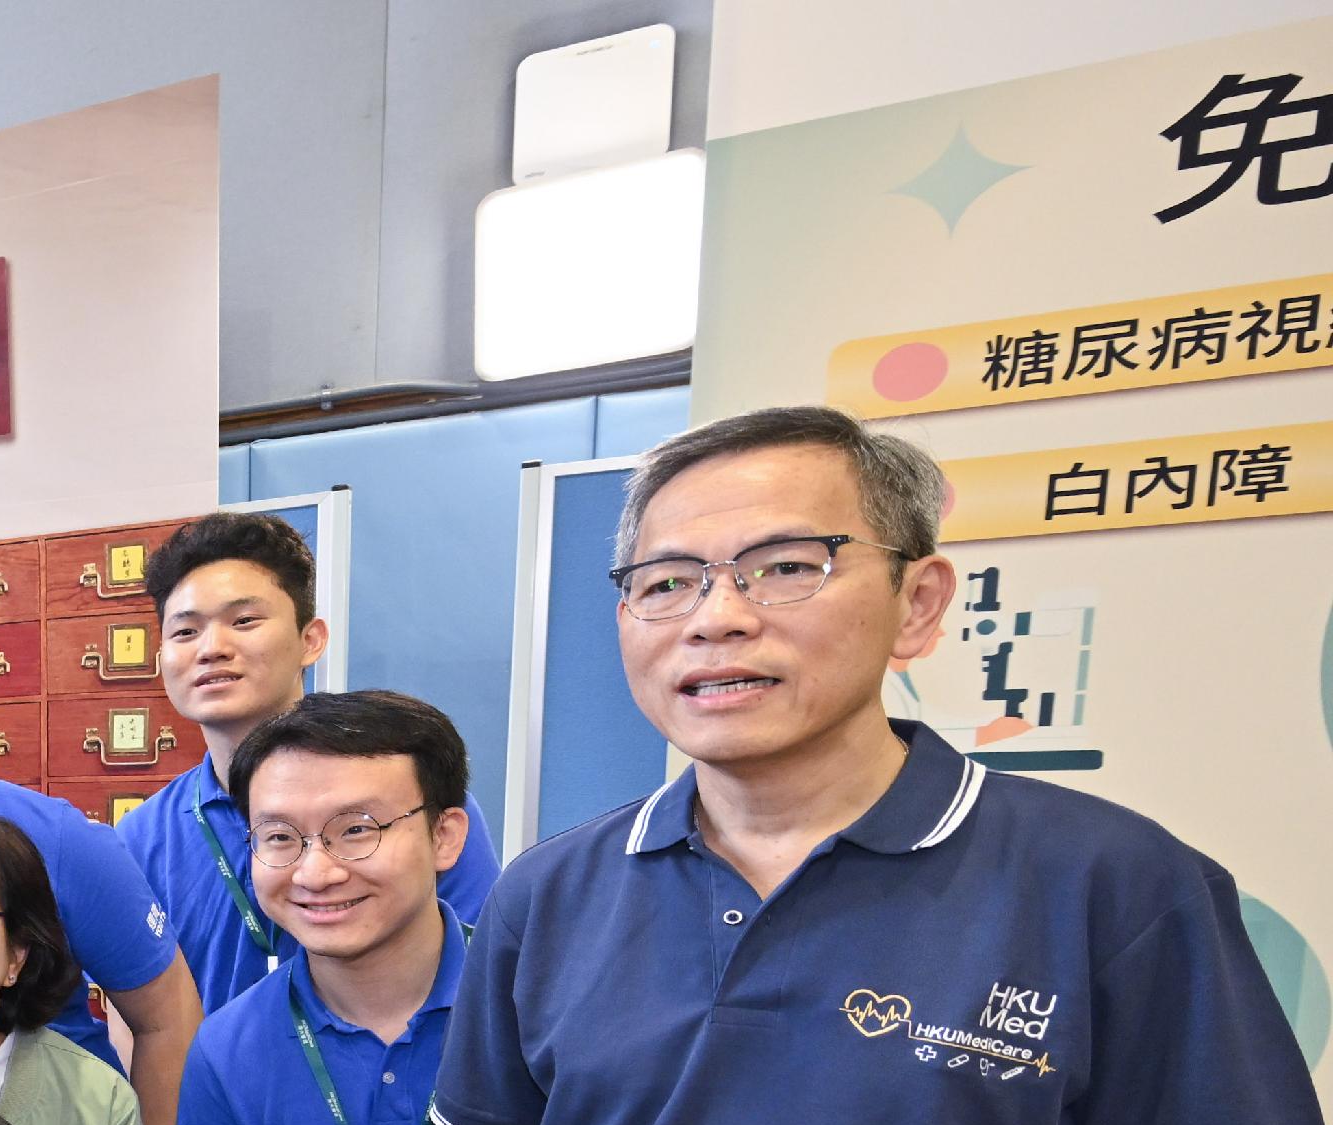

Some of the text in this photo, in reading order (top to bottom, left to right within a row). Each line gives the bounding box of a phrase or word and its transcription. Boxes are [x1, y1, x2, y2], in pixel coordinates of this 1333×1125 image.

[982, 293, 1333, 391] 糖尿病視
[988, 982, 1057, 1016] HKU
[915, 1022, 1033, 1060] HKUMediCare
[979, 1004, 1049, 1041] Med
